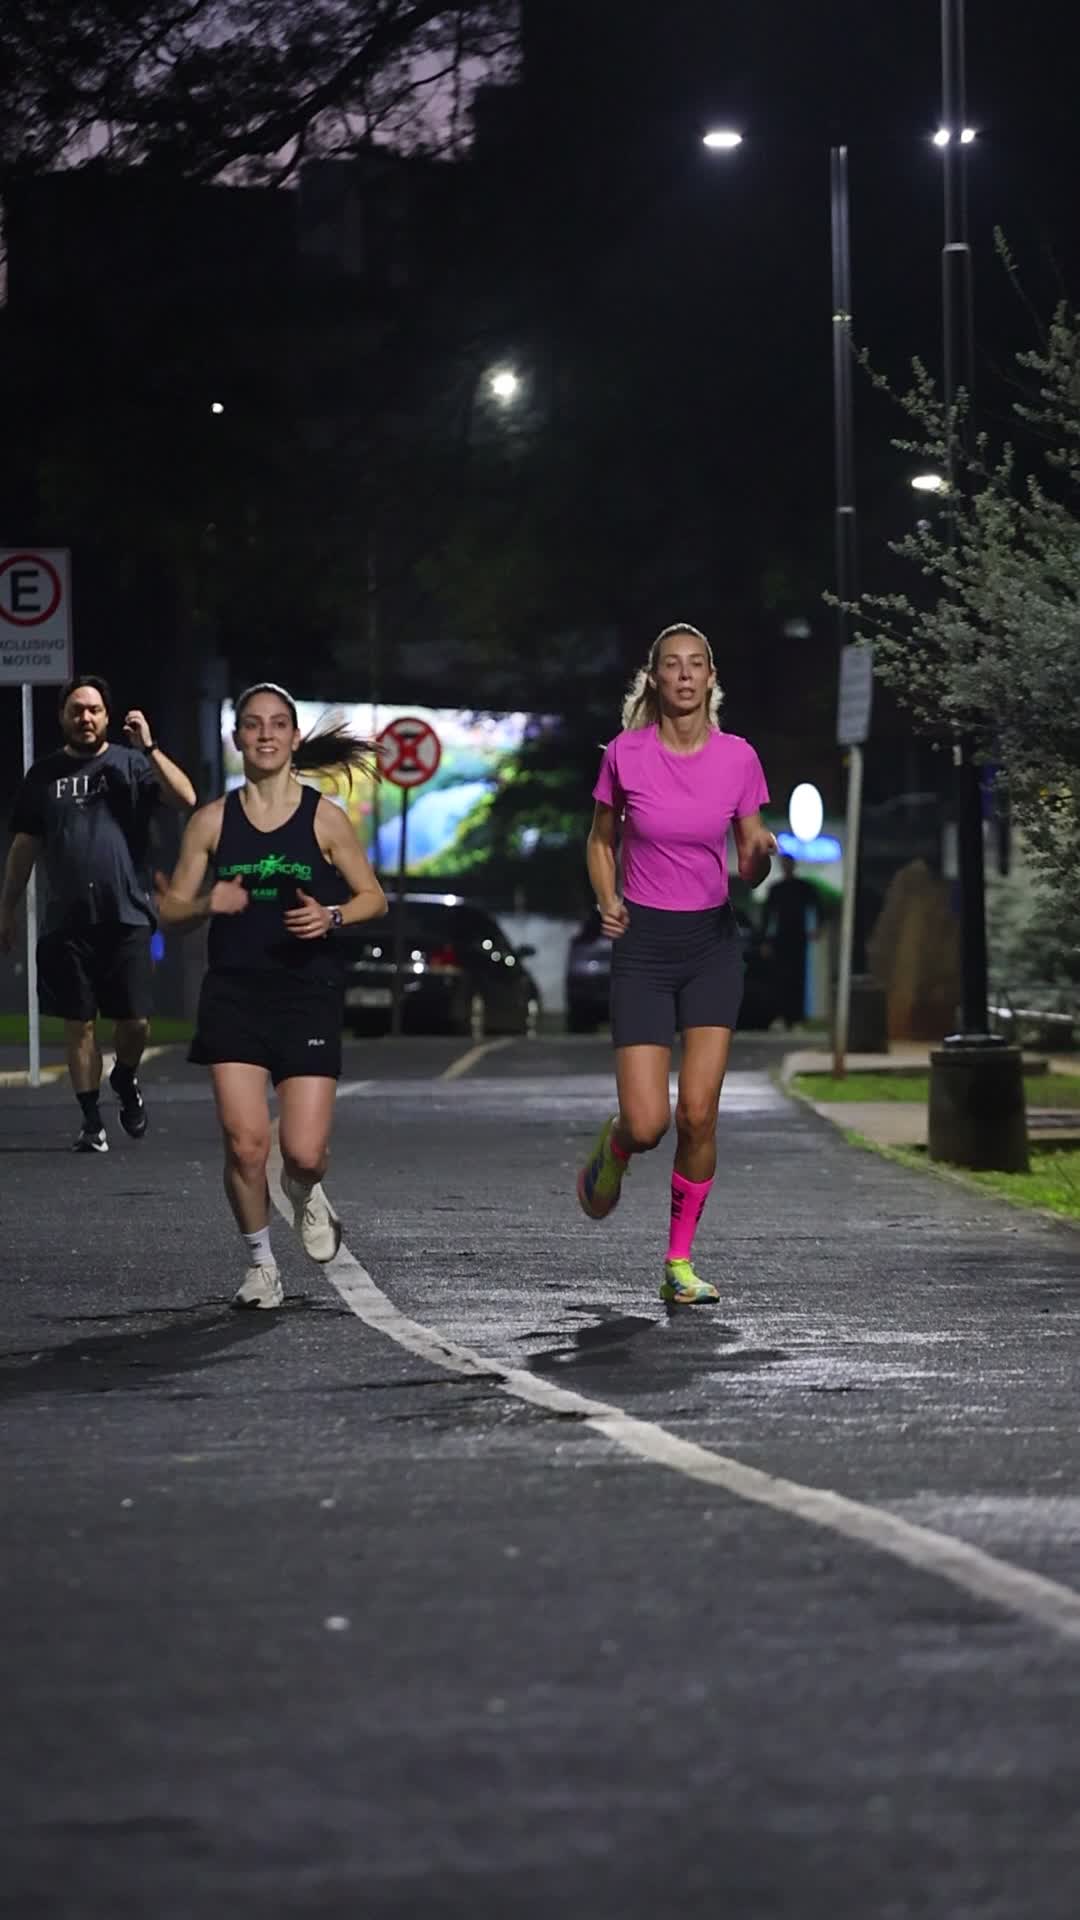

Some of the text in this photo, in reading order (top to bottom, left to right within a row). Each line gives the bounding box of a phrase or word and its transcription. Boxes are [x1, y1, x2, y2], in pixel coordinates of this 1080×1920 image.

[10, 569, 41, 612] E
[0, 639, 65, 650] XCLUSIVO
[2, 655, 52, 666] MOTOS
[56, 774, 110, 799] FILA
